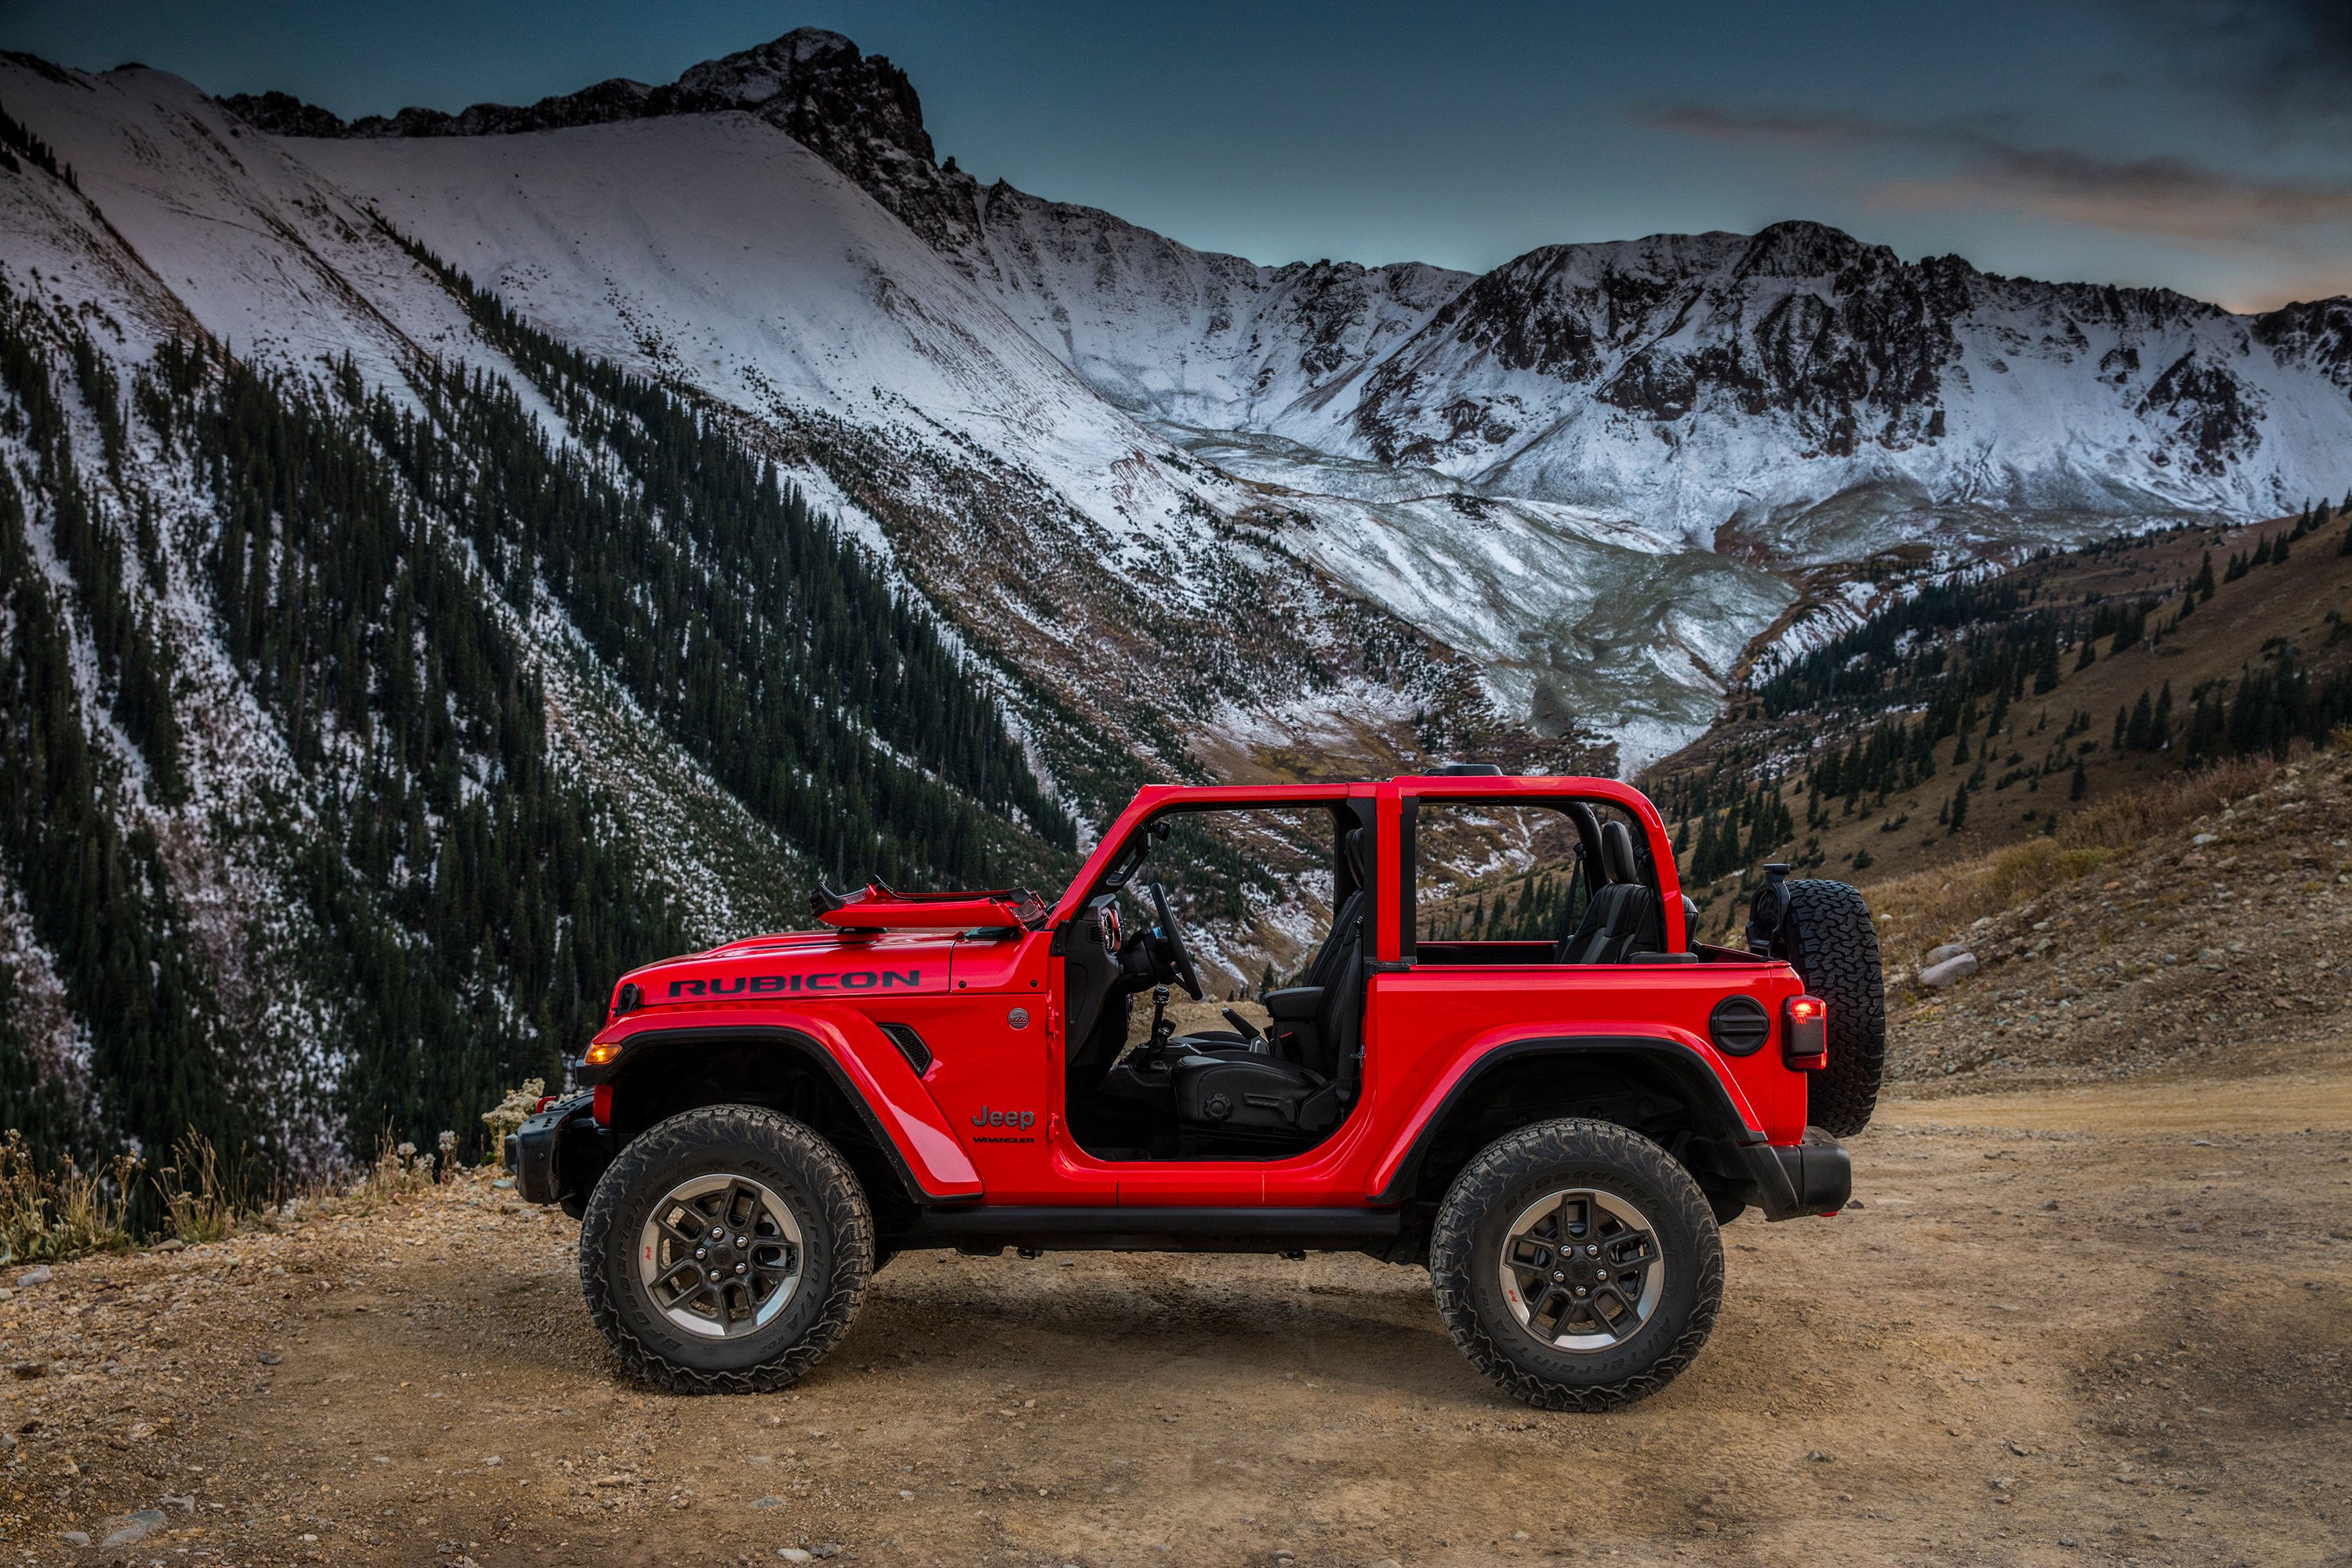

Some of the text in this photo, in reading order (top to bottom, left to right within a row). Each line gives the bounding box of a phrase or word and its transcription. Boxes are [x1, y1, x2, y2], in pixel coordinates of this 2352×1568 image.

[669, 971, 920, 997] RUBICON
[972, 1105, 1035, 1131] Jeep
[1503, 1170, 1663, 1216] BFGoodrich
[741, 1157, 826, 1285] All-Terrain
[616, 1195, 684, 1354] BFGoodrich
[783, 1290, 818, 1335] T/A
